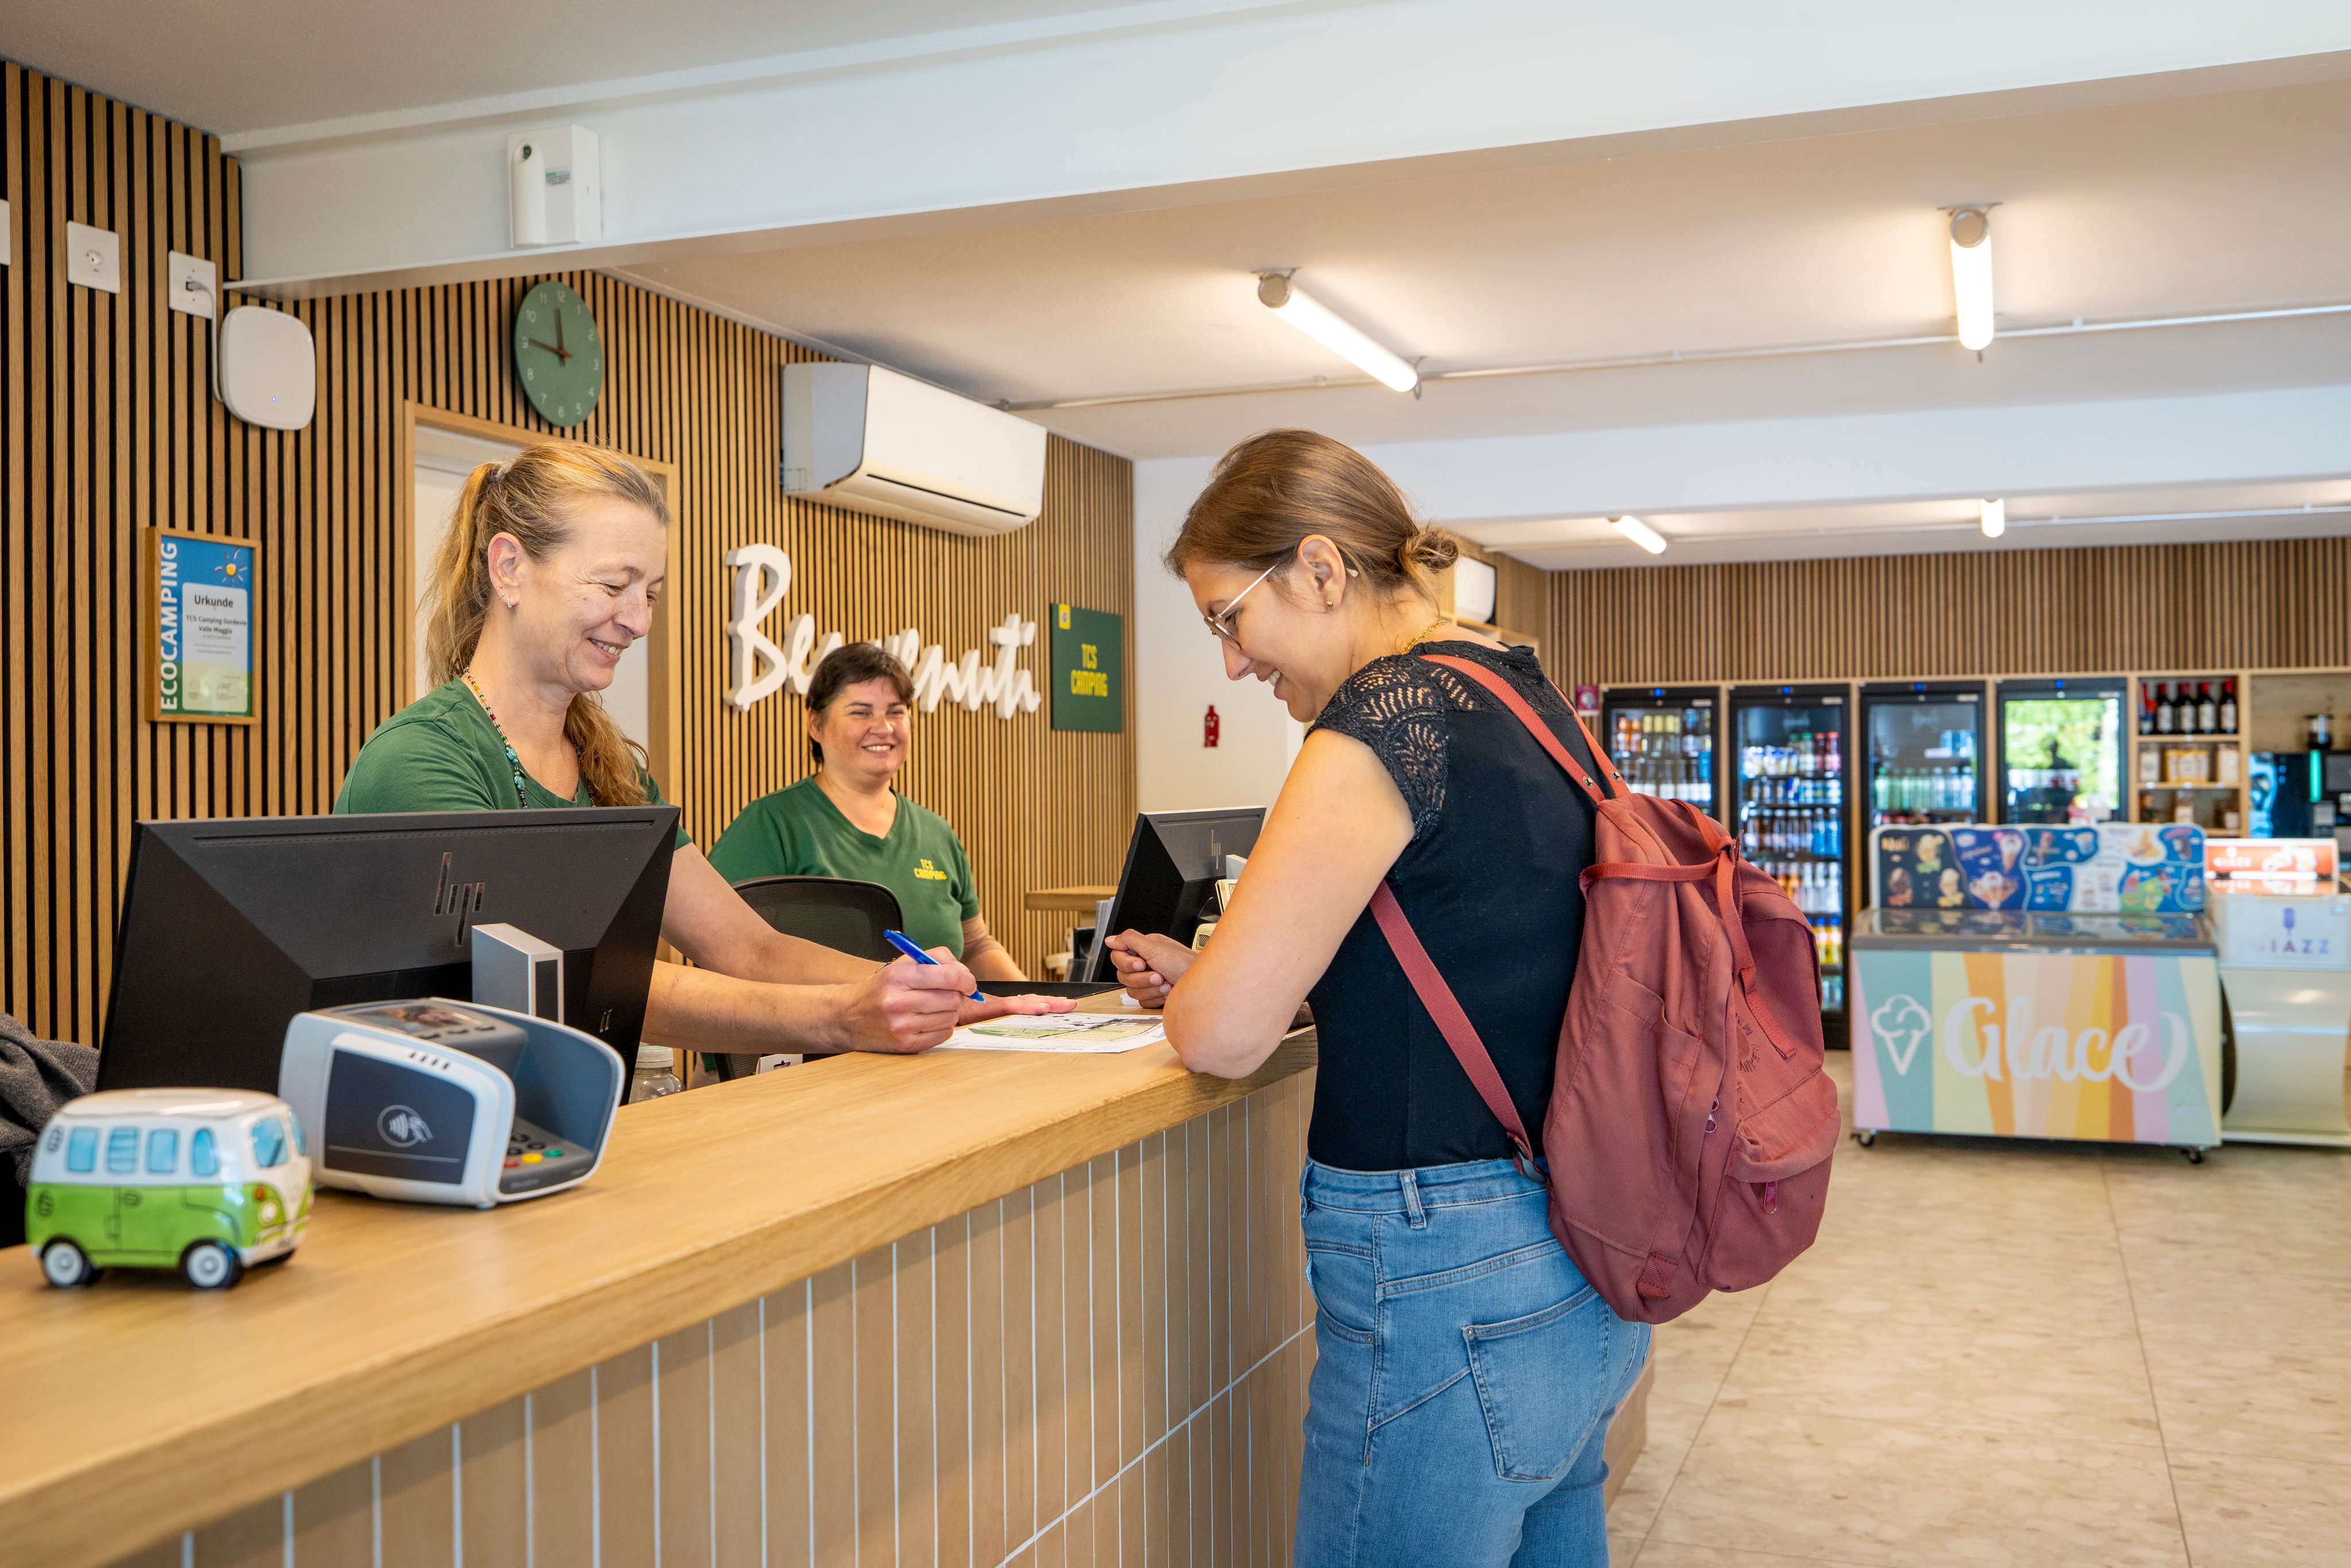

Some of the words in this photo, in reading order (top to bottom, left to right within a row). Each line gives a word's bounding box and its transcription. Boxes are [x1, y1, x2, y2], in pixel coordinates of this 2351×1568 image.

[540, 292, 548, 304] 11
[557, 289, 567, 303] 12
[526, 309, 537, 323] 10
[588, 329, 594, 341] 2
[521, 336, 529, 349] 9
[593, 359, 599, 371] 3
[526, 367, 534, 381] 8
[588, 386, 595, 397] 4
[541, 393, 547, 405] 7
[557, 406, 565, 418] 6
[576, 403, 582, 415] 5
[194, 595, 234, 608] Urkunde
[160, 542, 178, 710] ECOCAMPING
[198, 616, 222, 625] Camping
[725, 543, 1041, 720] Beenuti
[1081, 643, 1097, 670] TCS
[1070, 669, 1108, 697] CAMPING
[920, 859, 934, 870] TCS
[913, 867, 948, 880] CAMPING
[1943, 995, 2190, 1093] Glace
